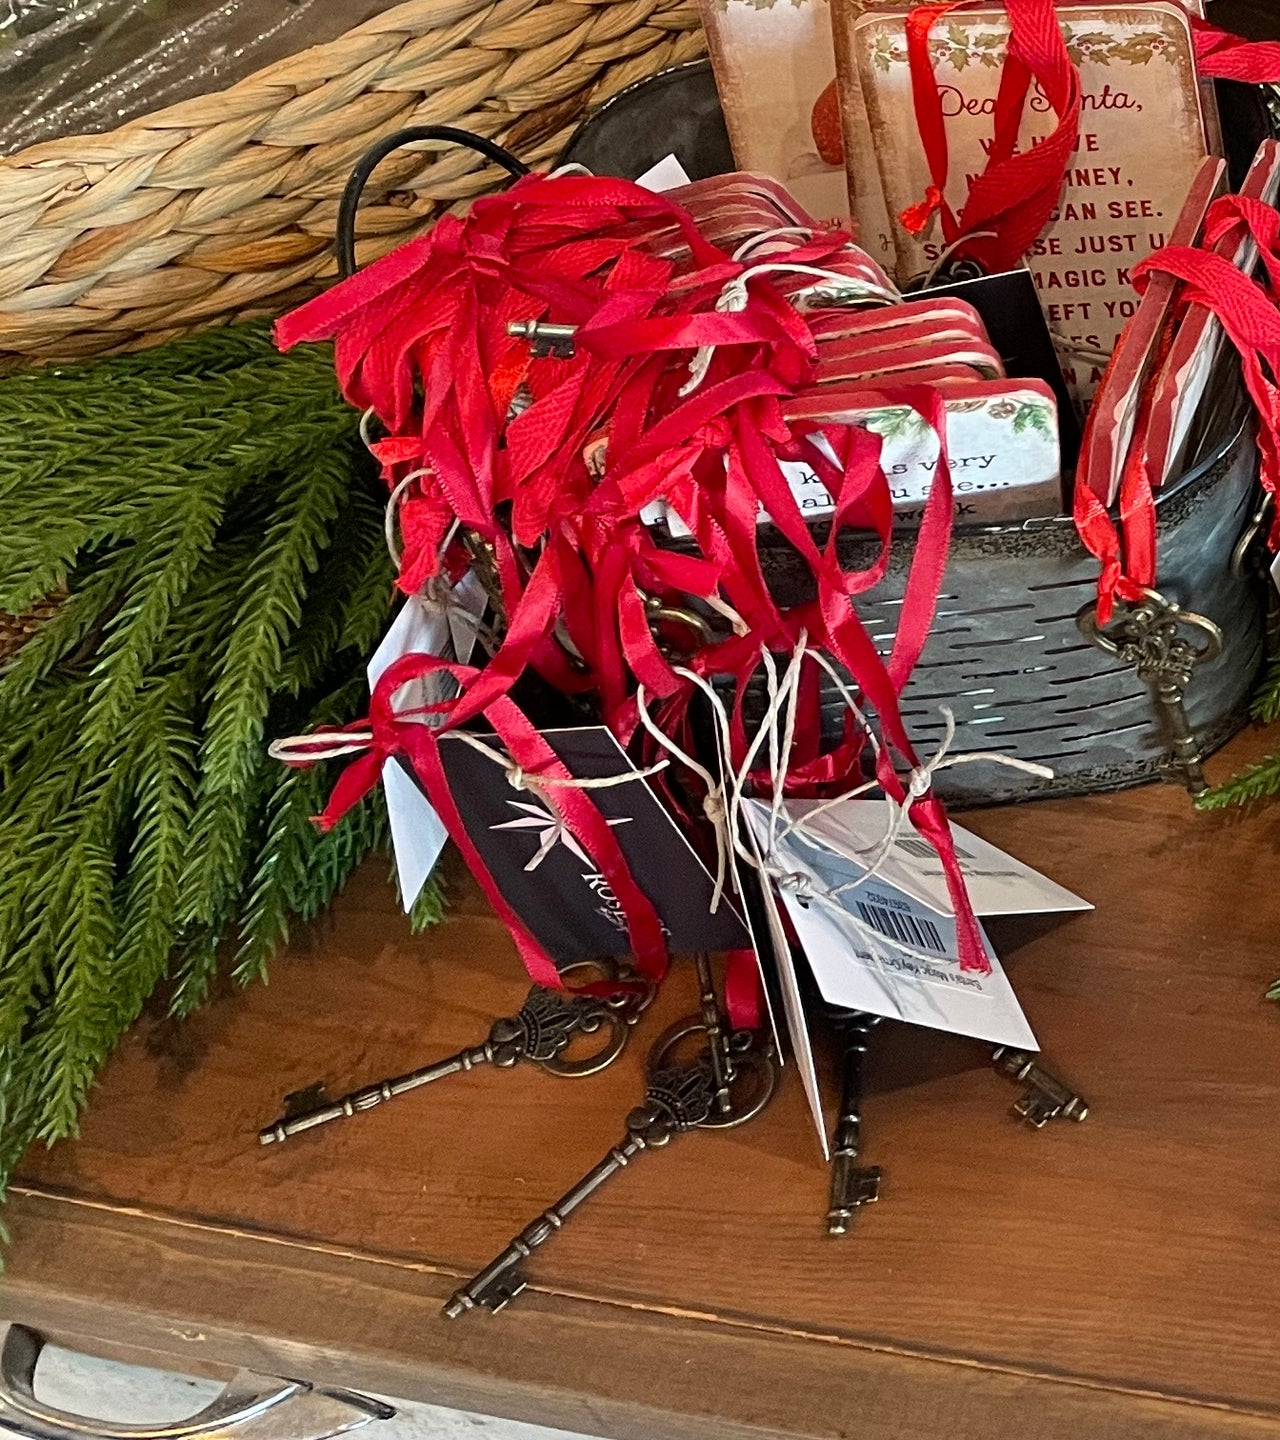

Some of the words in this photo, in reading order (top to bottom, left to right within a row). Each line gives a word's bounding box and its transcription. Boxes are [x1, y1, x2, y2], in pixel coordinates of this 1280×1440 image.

[936, 84, 998, 117] Dea
[1030, 83, 1143, 113] Snta,
[1109, 199, 1164, 220] SEE.
[1074, 234, 1138, 255] JUST
[1050, 303, 1092, 322] EFT
